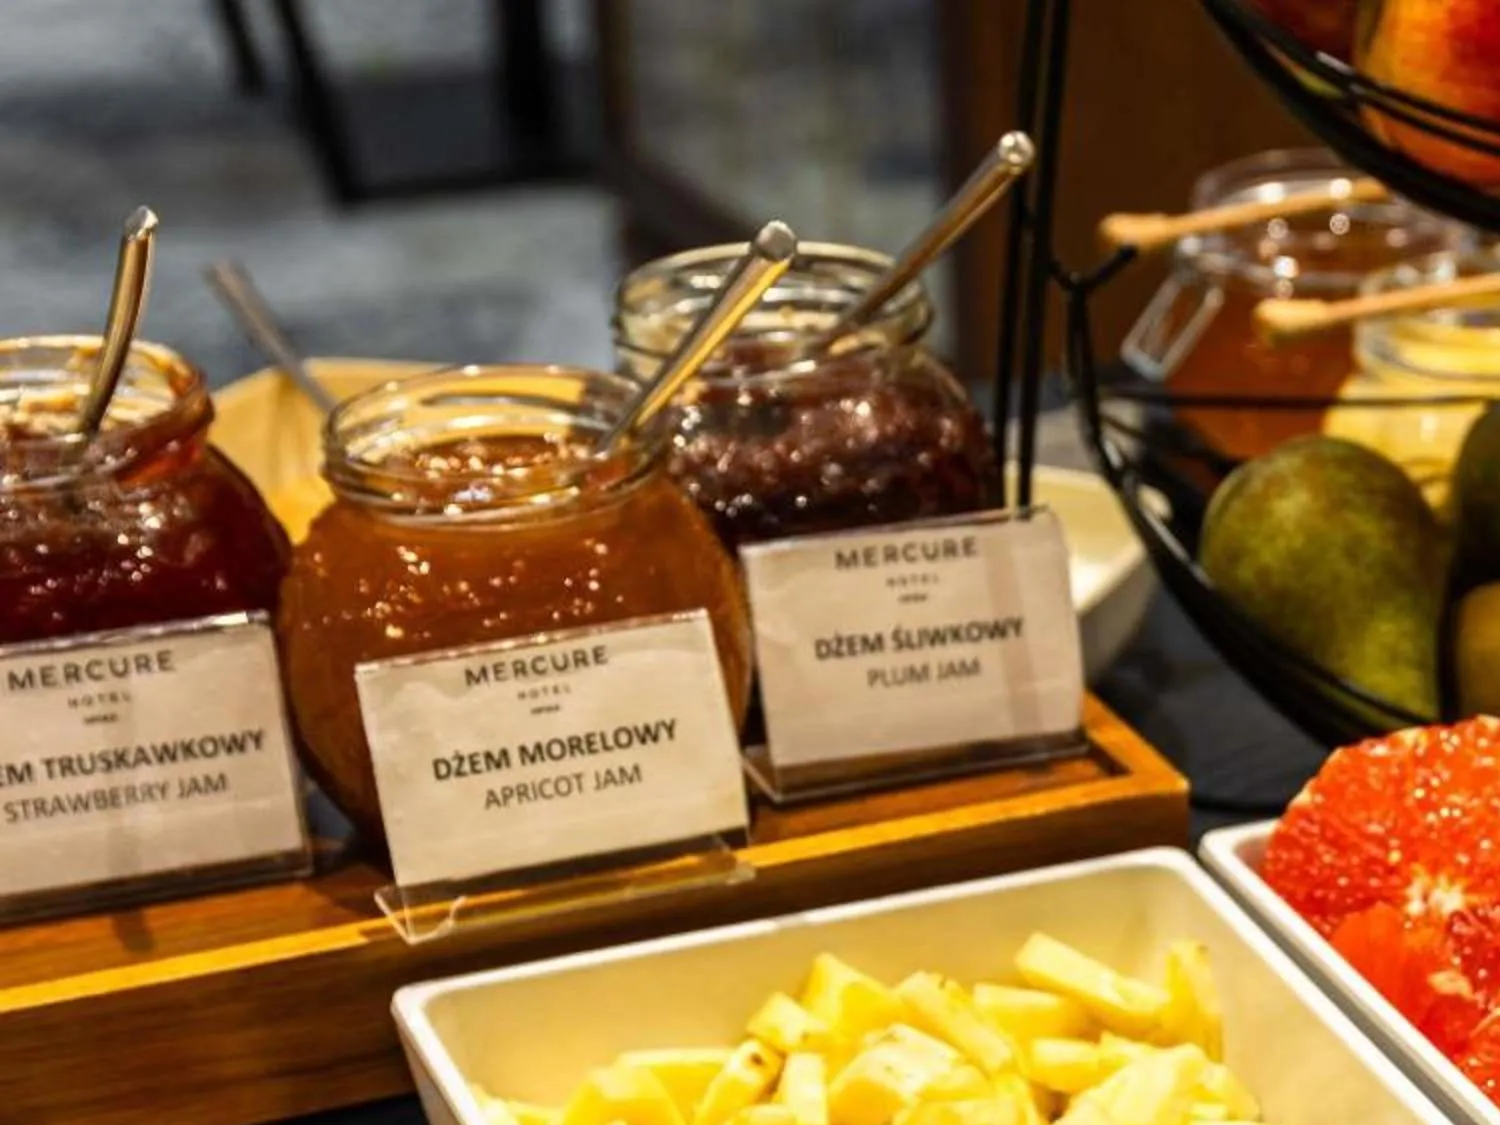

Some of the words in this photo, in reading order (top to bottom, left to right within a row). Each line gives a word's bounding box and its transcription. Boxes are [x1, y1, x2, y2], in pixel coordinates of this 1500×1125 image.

[835, 536, 978, 569] MERCURE
[815, 632, 885, 661] DŻEM
[891, 617, 1024, 652] ŚLIWKOWY
[7, 650, 175, 690] MERCURE
[464, 645, 609, 687] MERCURE
[866, 667, 930, 688] PLUM
[936, 657, 981, 681] JAM
[67, 691, 132, 709] HOTEL
[516, 683, 572, 701] HOTEL
[41, 730, 264, 780] TRUSKAWKOWY
[432, 747, 511, 781] DŻEM
[517, 719, 678, 766] MORELOWY
[3, 782, 168, 823] STRAWBERRY
[178, 773, 228, 799] JAM
[484, 773, 586, 810] APRICOT
[593, 764, 642, 792] JAM
